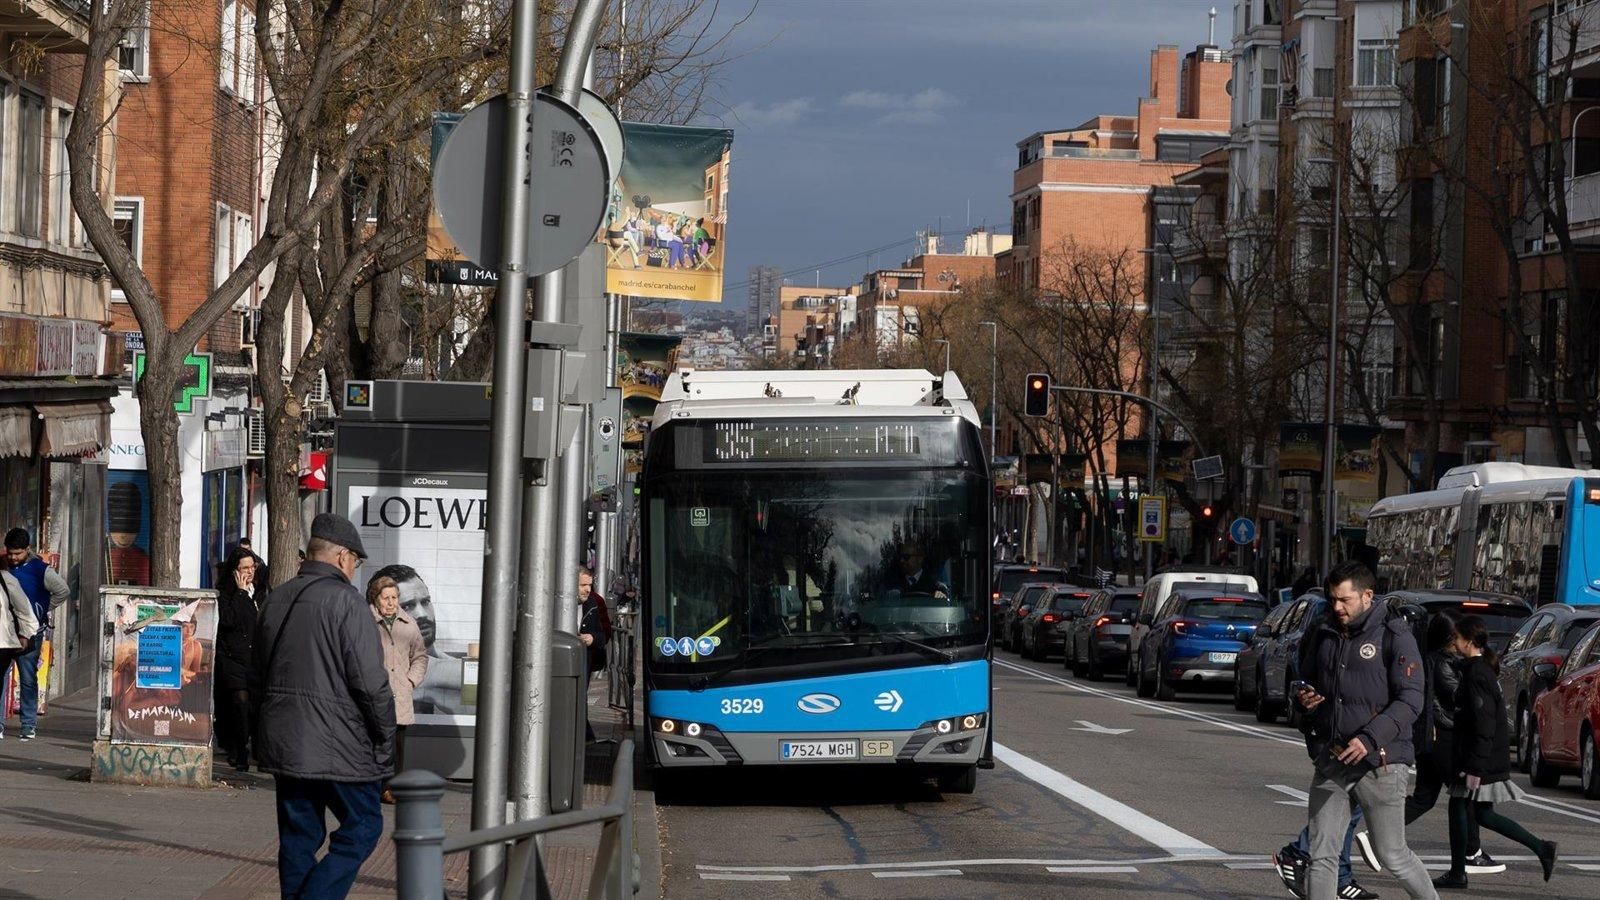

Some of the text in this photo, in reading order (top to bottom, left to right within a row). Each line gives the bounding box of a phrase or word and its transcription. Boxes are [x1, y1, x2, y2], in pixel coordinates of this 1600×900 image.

[618, 280, 697, 292] madrid.es/carabanchel
[412, 478, 449, 486] JCDecaux
[720, 698, 764, 714] 3529
[791, 743, 854, 758] 7524 MGH
[867, 742, 890, 755] SP
